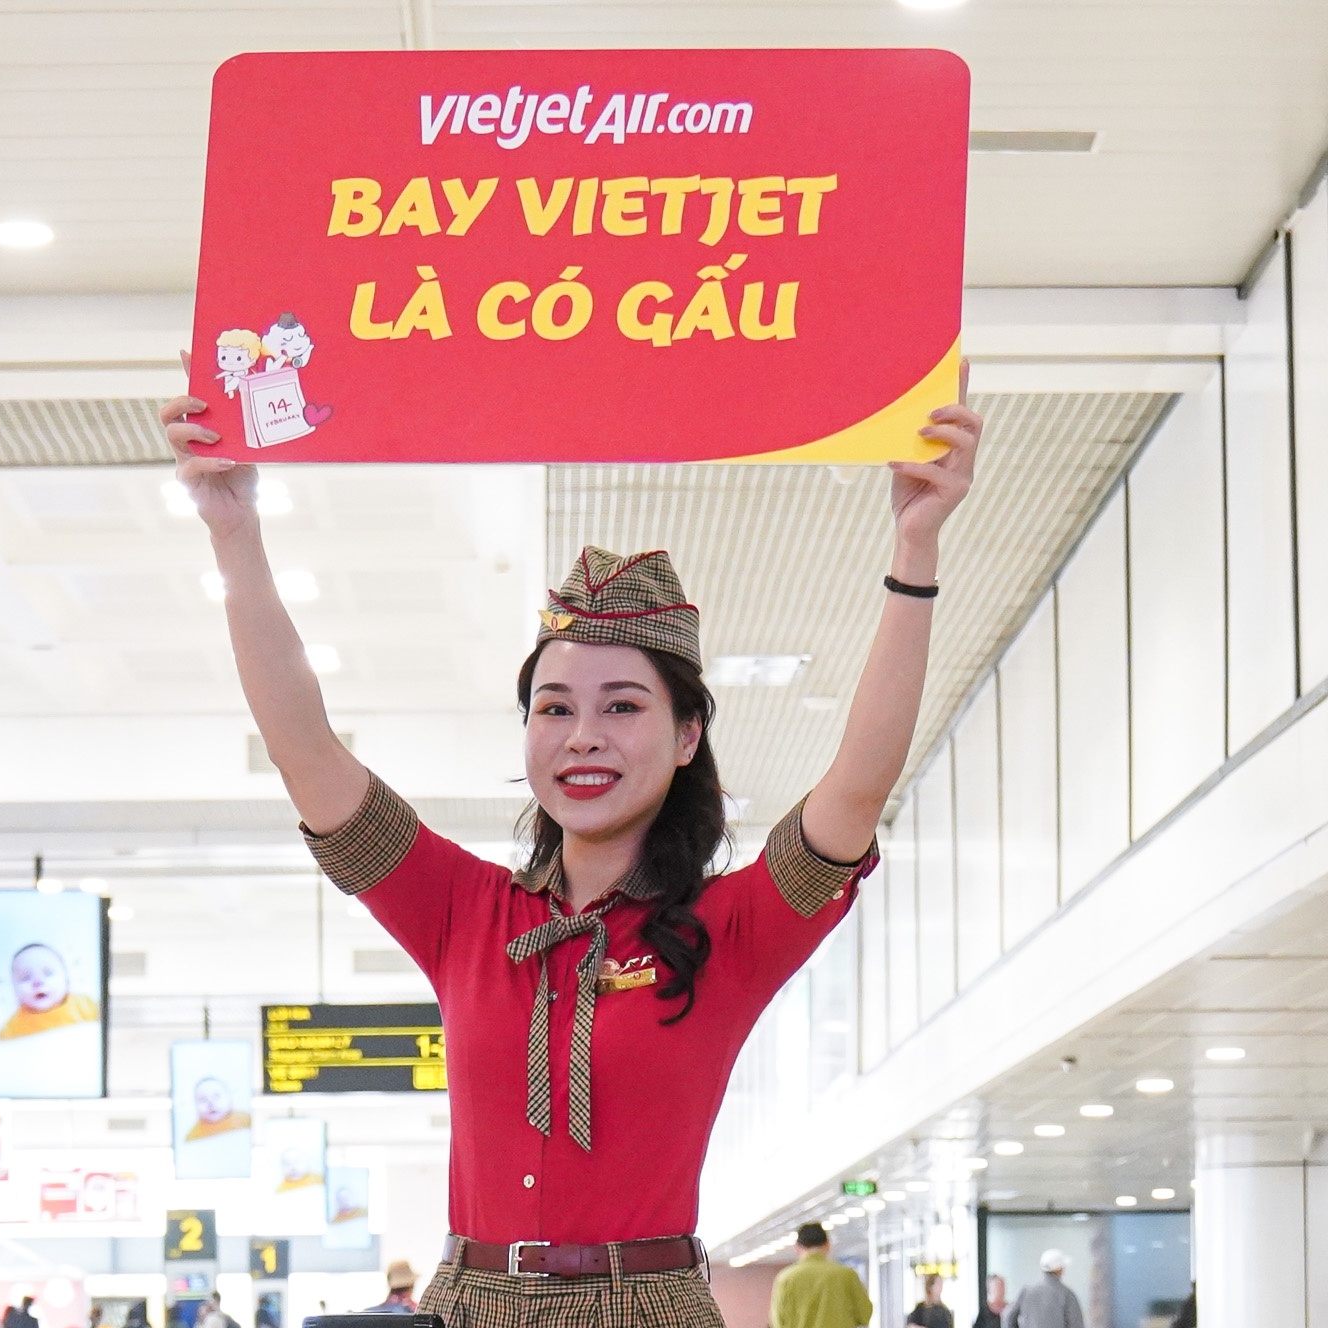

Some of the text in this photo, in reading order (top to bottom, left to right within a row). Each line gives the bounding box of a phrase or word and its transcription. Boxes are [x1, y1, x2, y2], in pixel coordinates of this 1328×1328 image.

[327, 174, 838, 247] BAY VIETJET
[349, 253, 801, 348] LÀ CÓ GẤU
[268, 398, 293, 415] 14
[178, 1216, 204, 1252] 2
[259, 1244, 277, 1274] 1
